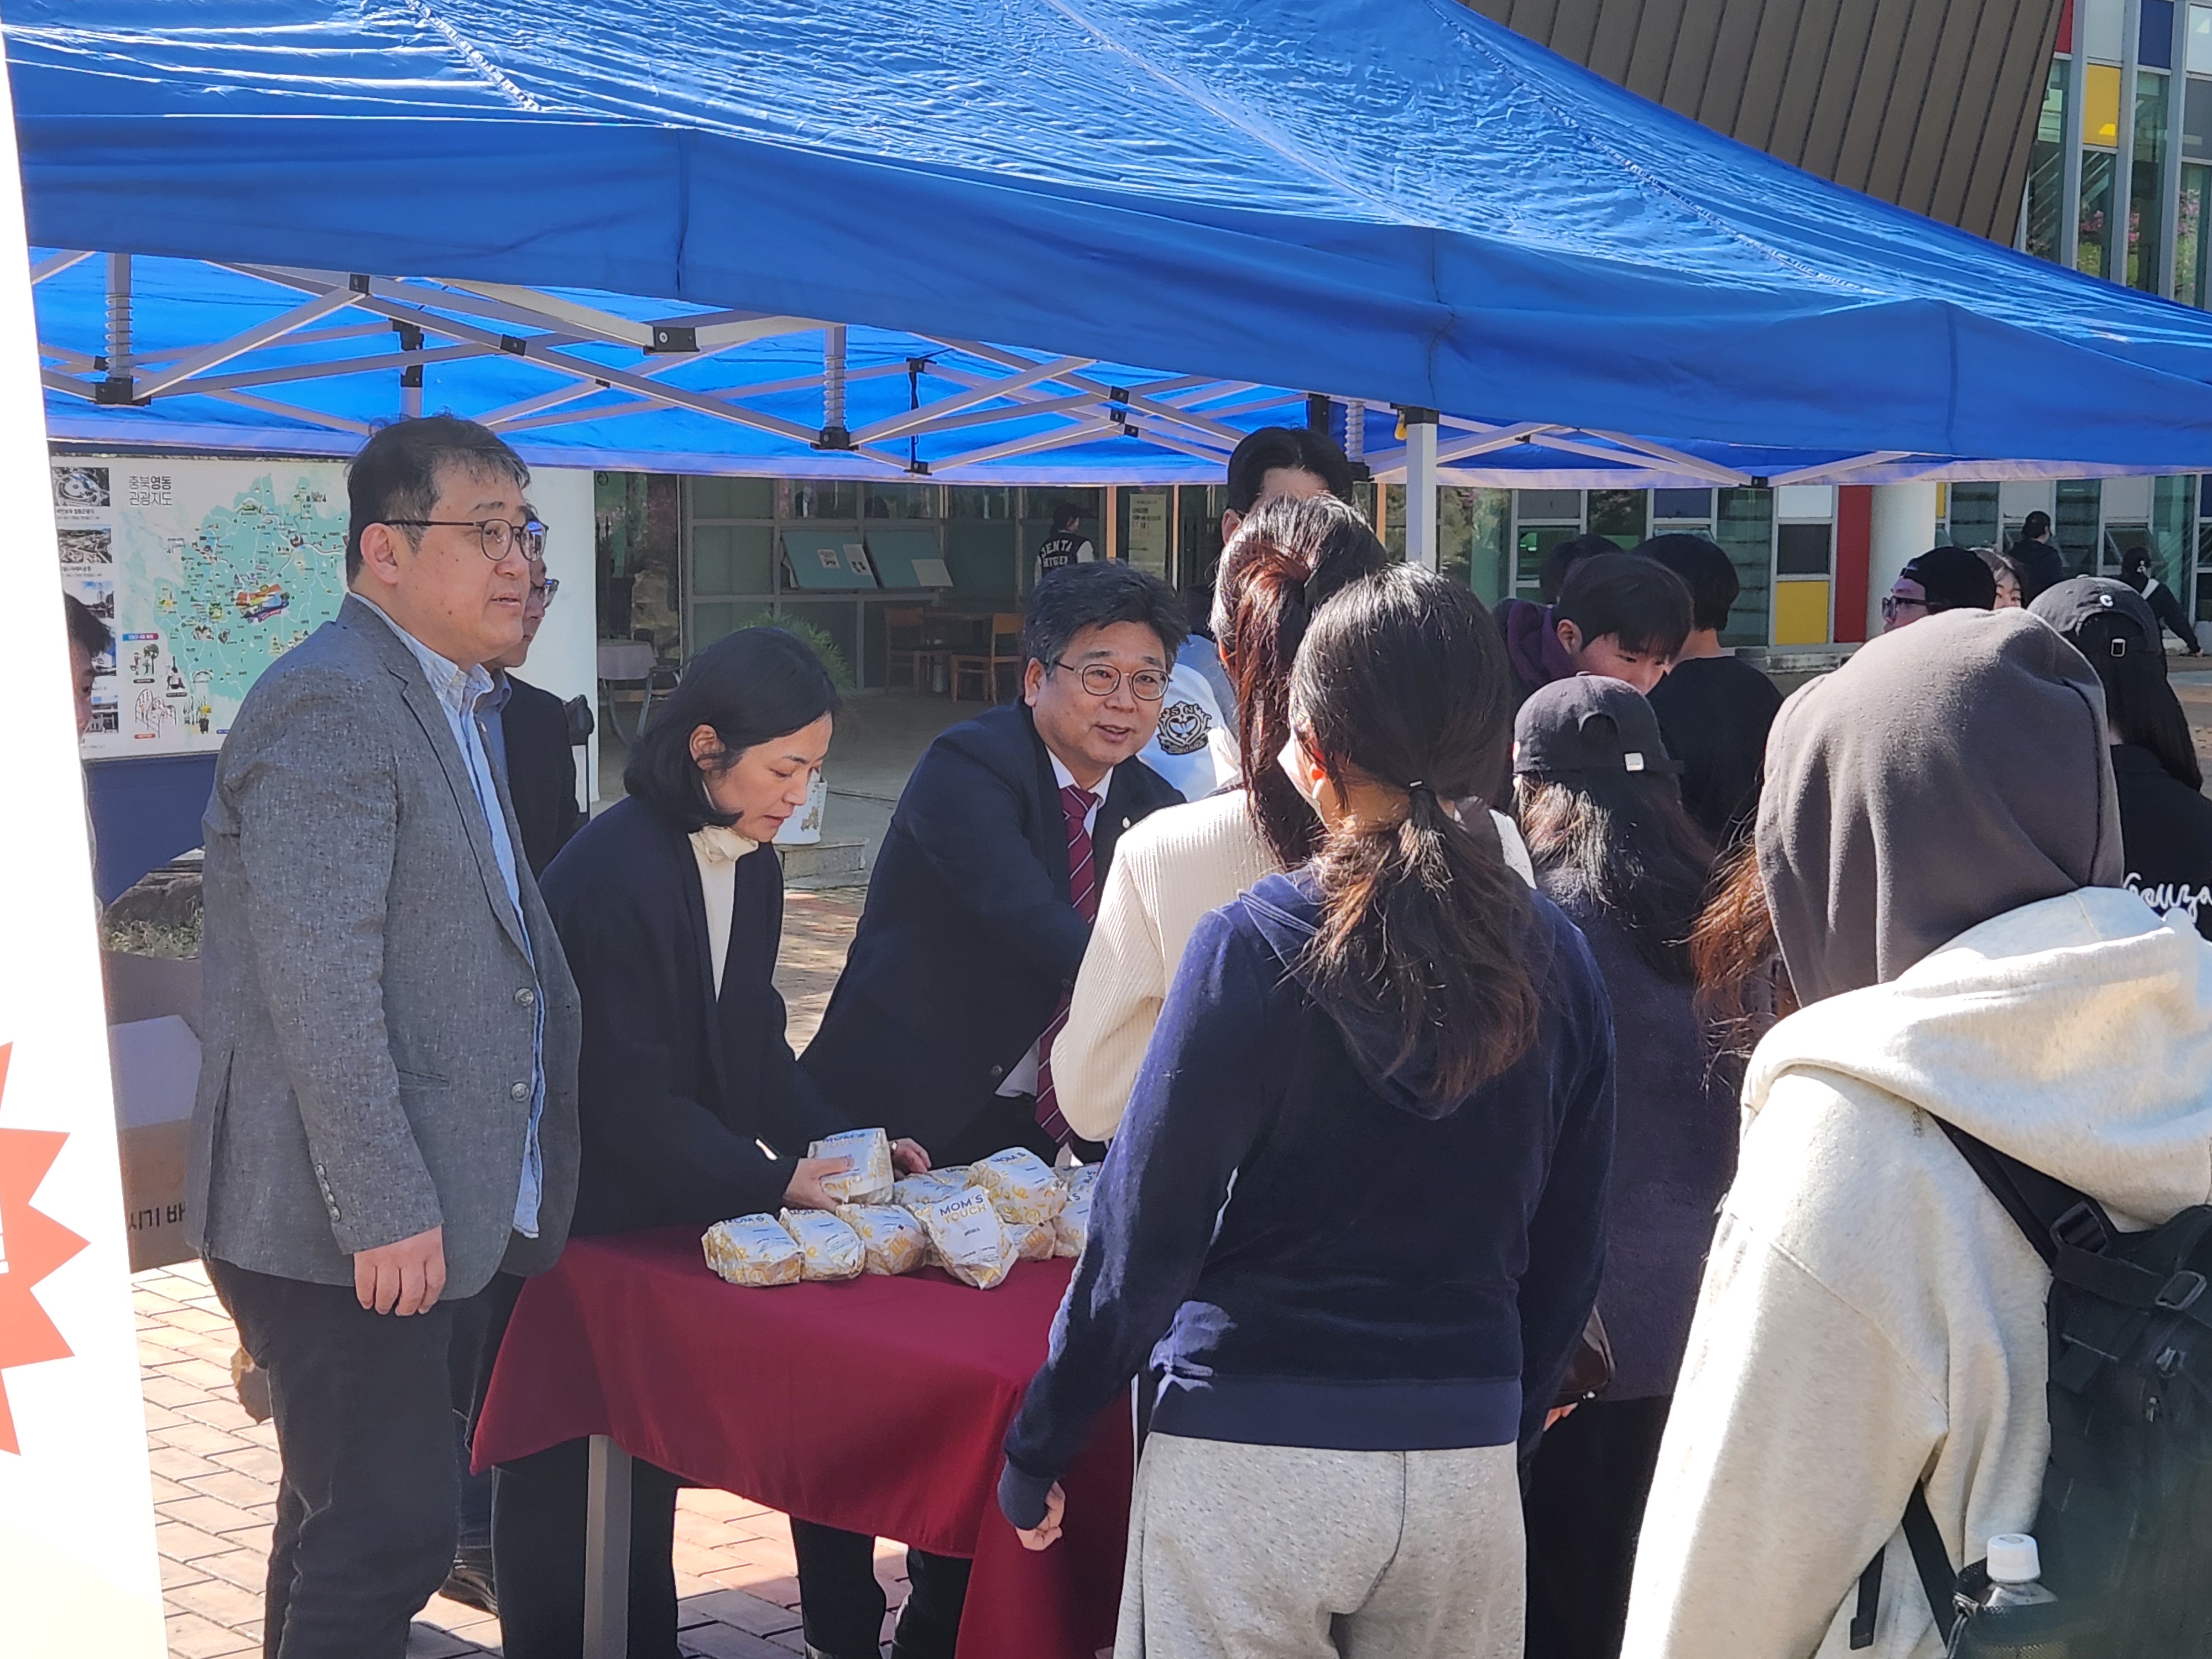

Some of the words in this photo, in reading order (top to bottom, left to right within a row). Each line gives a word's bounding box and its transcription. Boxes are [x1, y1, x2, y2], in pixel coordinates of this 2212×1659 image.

[128, 476, 171, 490] 충북영동
[129, 491, 173, 506] 관광지도
[2100, 594, 2114, 607] C
[940, 1194, 984, 1217] MOM'S
[943, 1204, 987, 1224] TOUCH
